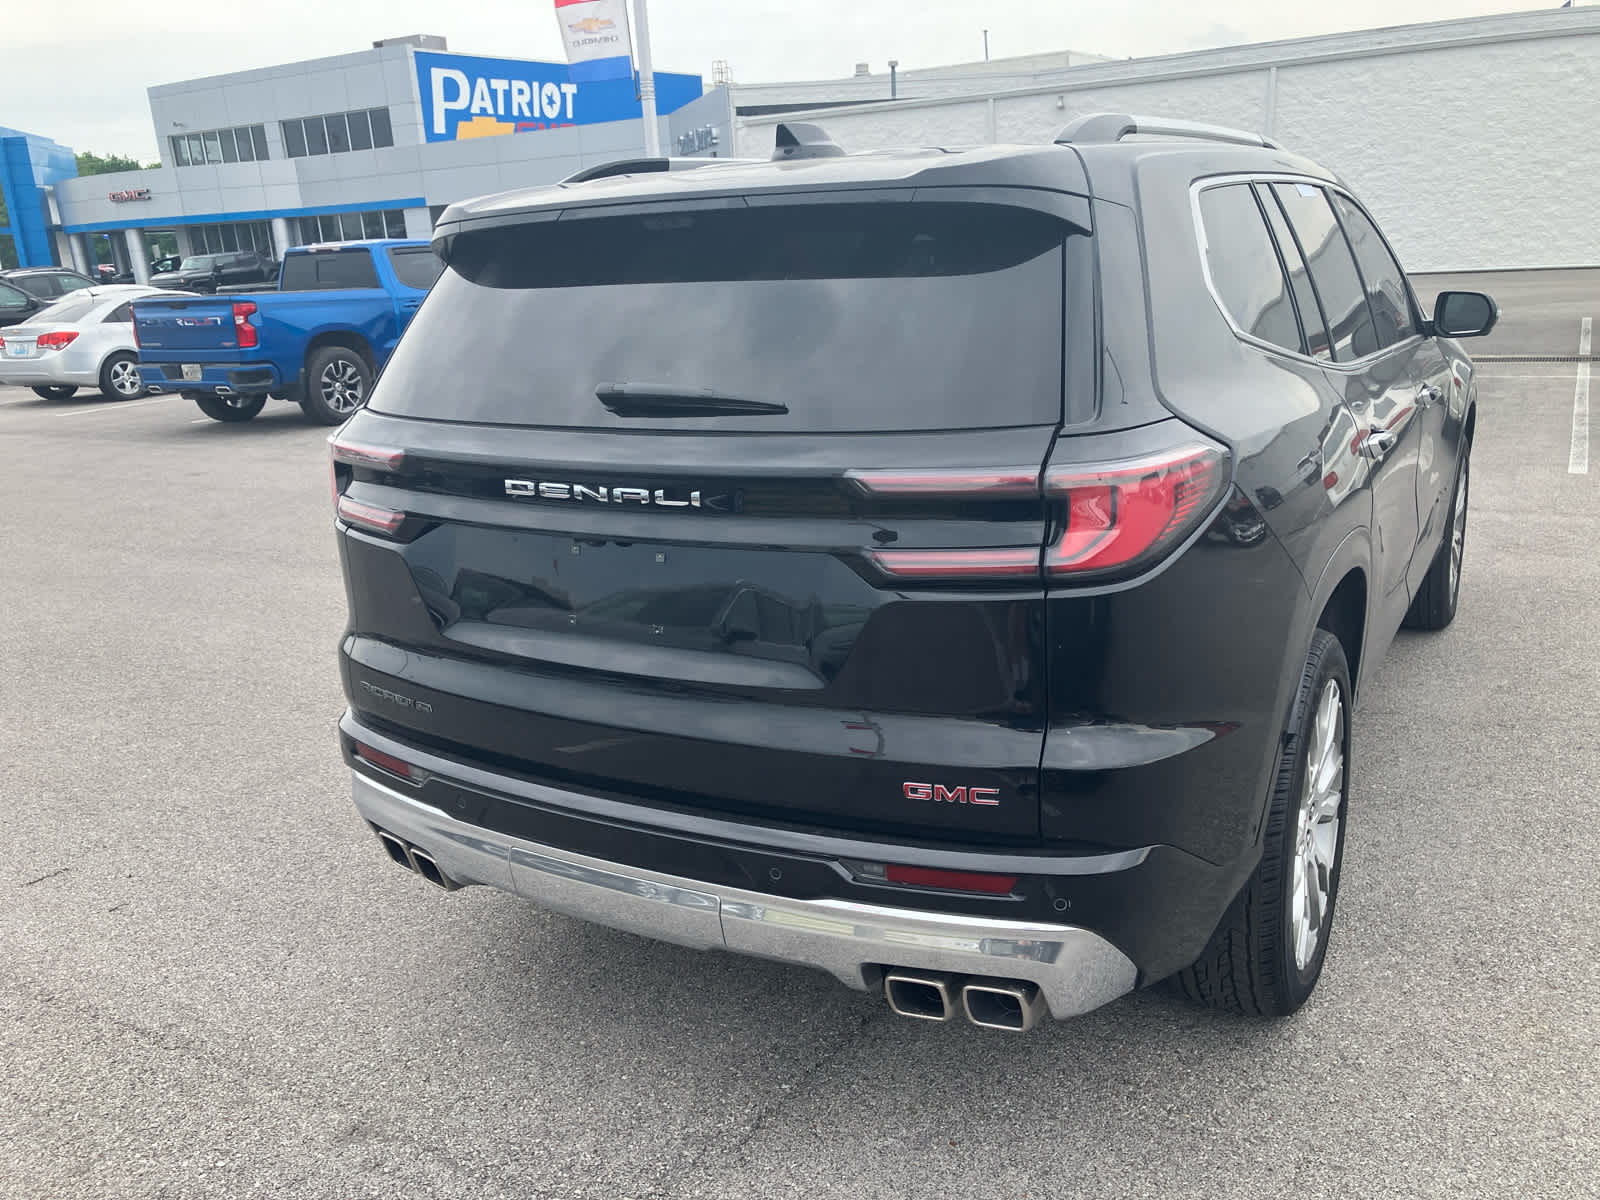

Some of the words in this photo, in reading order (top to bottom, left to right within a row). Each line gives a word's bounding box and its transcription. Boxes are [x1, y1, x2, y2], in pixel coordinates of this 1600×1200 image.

[430, 67, 578, 134] PATRIOT
[108, 189, 149, 202] GMC
[504, 479, 701, 508] DENALI
[903, 782, 1000, 806] GMC
